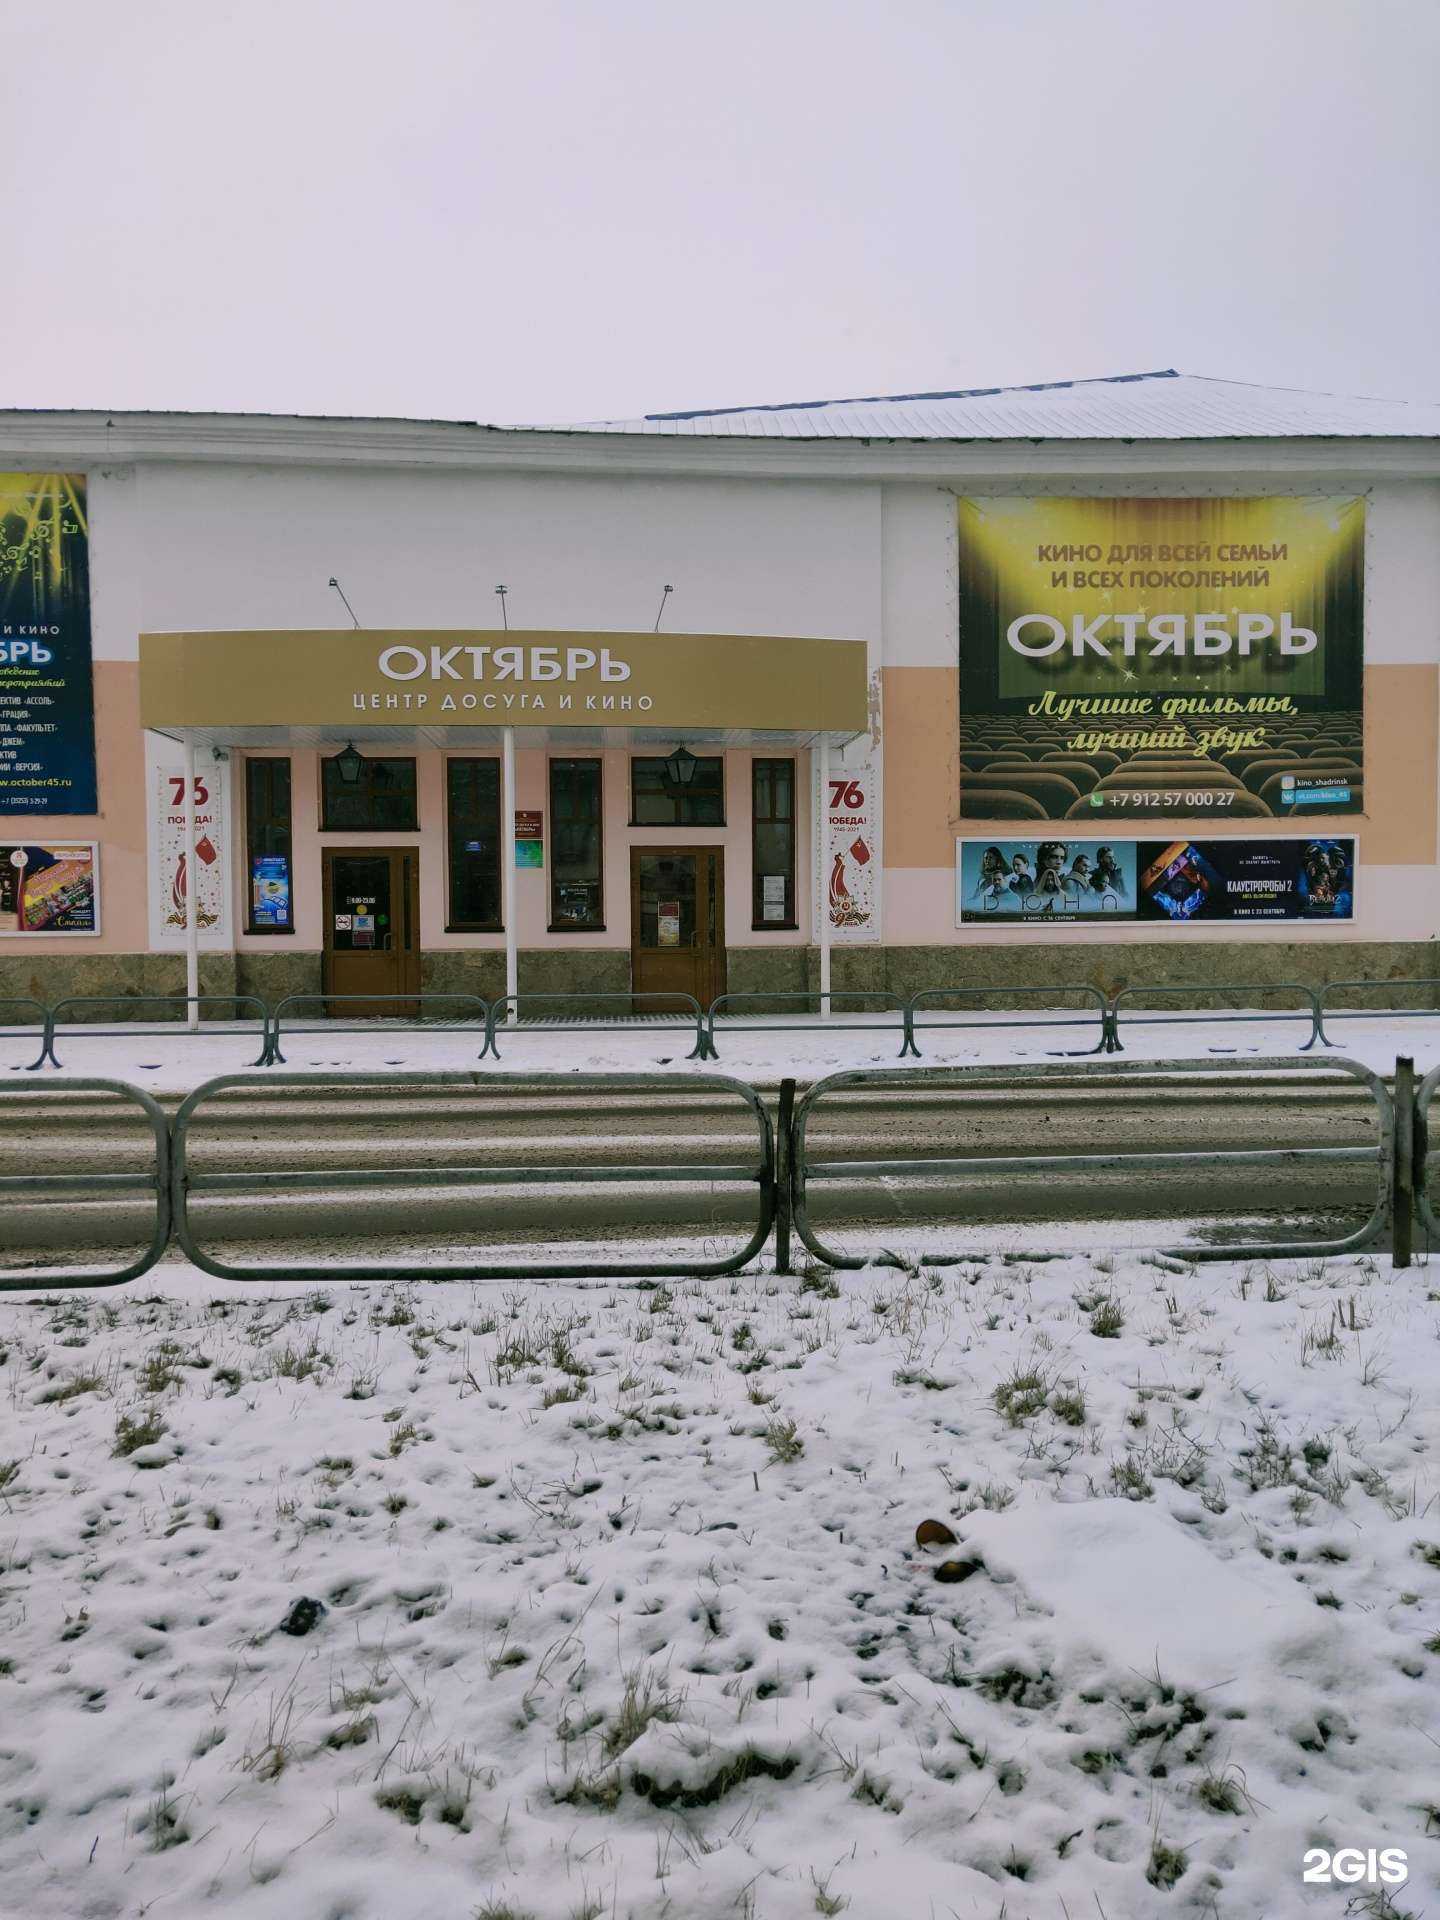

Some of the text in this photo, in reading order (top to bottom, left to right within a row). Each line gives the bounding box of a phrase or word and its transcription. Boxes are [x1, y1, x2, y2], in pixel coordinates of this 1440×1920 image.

[1038, 541, 1288, 564] КИНО ДЛЯ ВСЕЙ СЕМЬИ
[1051, 566, 1270, 588] И ВСЕХ ПОКОЛЕНИЙ
[3, 625, 60, 635] И КИНО
[1006, 612, 1318, 657] ОКТЯБРЬ
[378, 645, 631, 682] ОКТЯБРЬ
[353, 693, 653, 711] ЦЕНТР ДОСУГА И КИНО
[1028, 690, 1299, 721] Лучшие фильмы,
[1067, 726, 1266, 756] лучший звук
[829, 781, 865, 809] 76
[1109, 792, 1236, 807] +7 912 57 000 27
[1227, 880, 1293, 892] КЛАУСТРОФОБЫ 2
